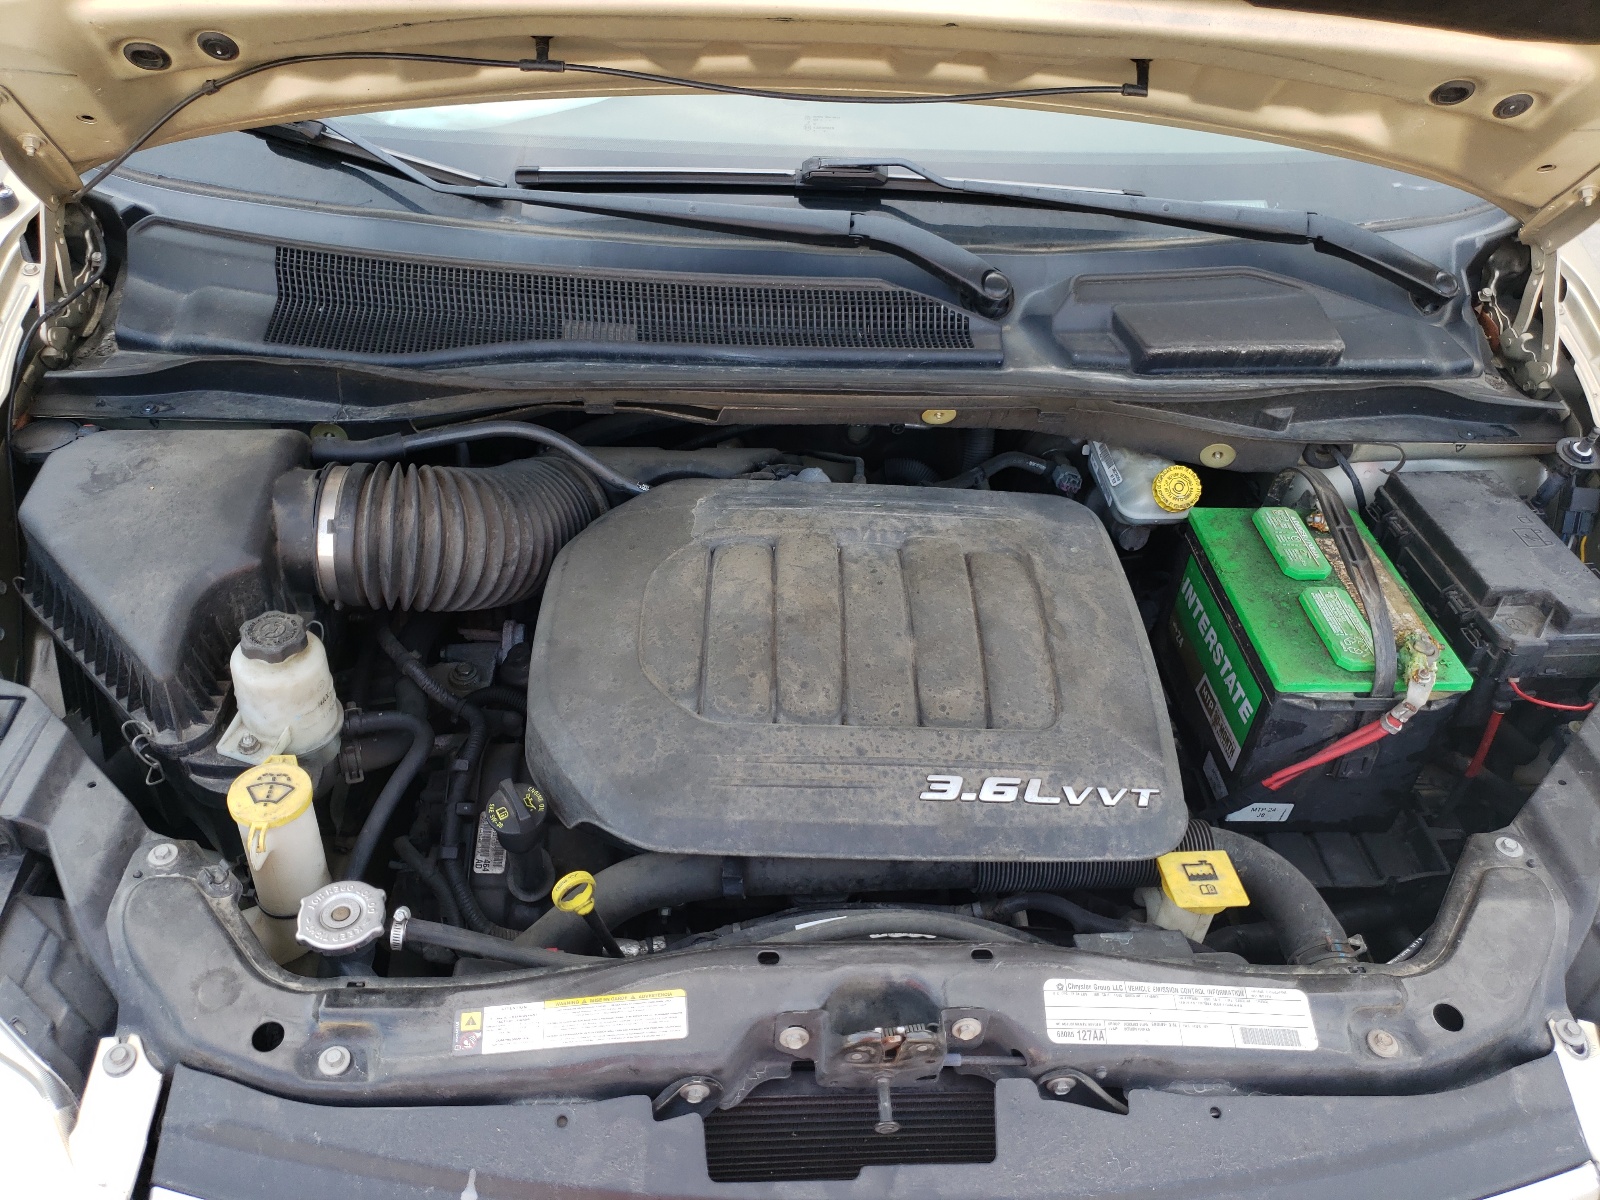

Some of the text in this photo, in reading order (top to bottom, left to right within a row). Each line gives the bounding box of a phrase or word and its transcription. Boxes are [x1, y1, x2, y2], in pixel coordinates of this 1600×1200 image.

[1181, 576, 1254, 725] INTERSTATE
[1201, 685, 1214, 710] MTP
[527, 786, 545, 802] ENGINE
[1062, 785, 1160, 808] VVT
[475, 858, 482, 869] AD
[482, 859, 491, 872] 464
[325, 885, 354, 896] OPEN
[308, 894, 325, 910] HOT
[1180, 987, 1205, 995] CONTROL
[1206, 989, 1245, 997] INFORMATION
[1076, 1029, 1105, 1041] 127AA
